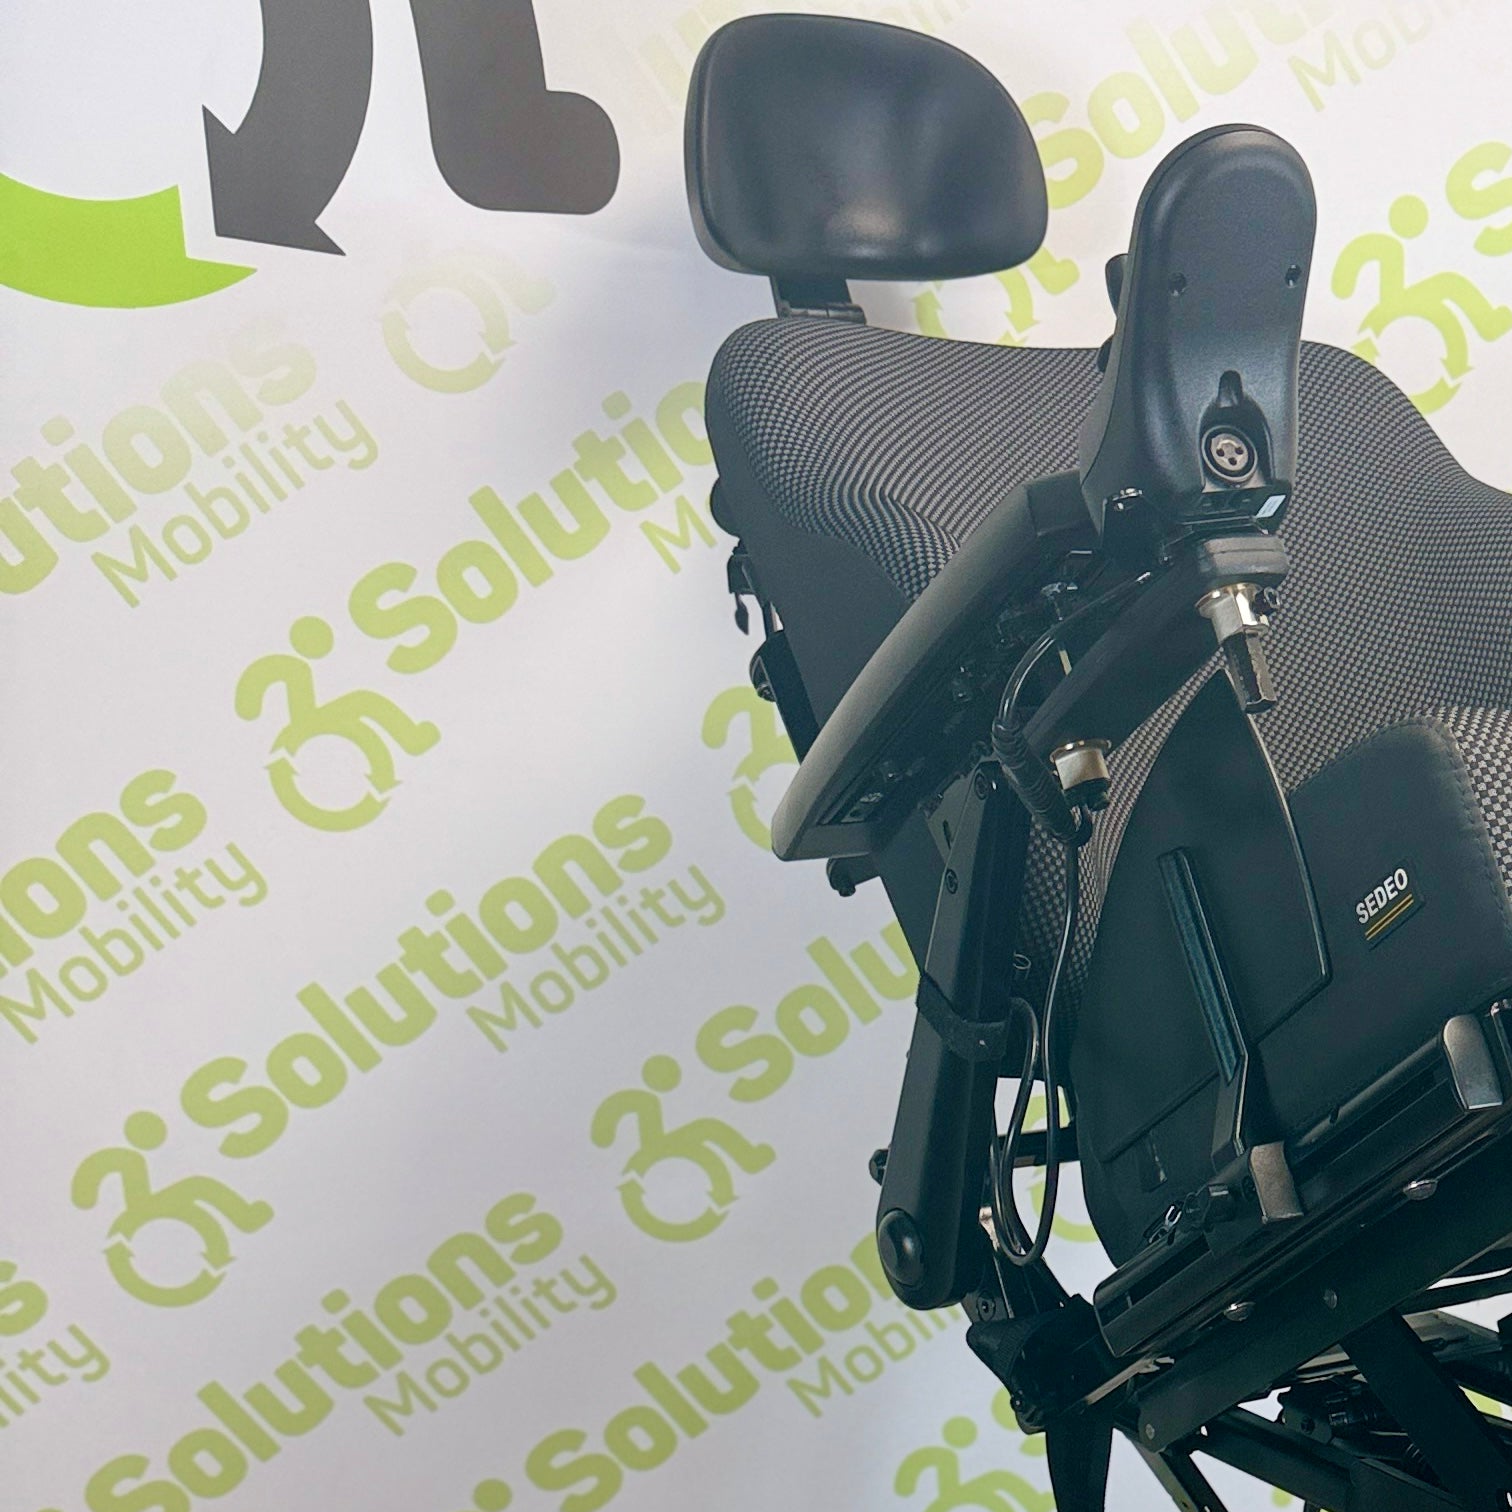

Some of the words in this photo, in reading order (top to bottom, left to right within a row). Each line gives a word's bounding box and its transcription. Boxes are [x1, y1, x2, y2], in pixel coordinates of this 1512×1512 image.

[91, 399, 379, 608] Mobility
[0, 842, 268, 1045] Mobility
[180, 794, 672, 1158] Solutions
[464, 859, 726, 1054] Mobility
[1355, 867, 1408, 924] SEDEO
[362, 1248, 617, 1437] Mobility
